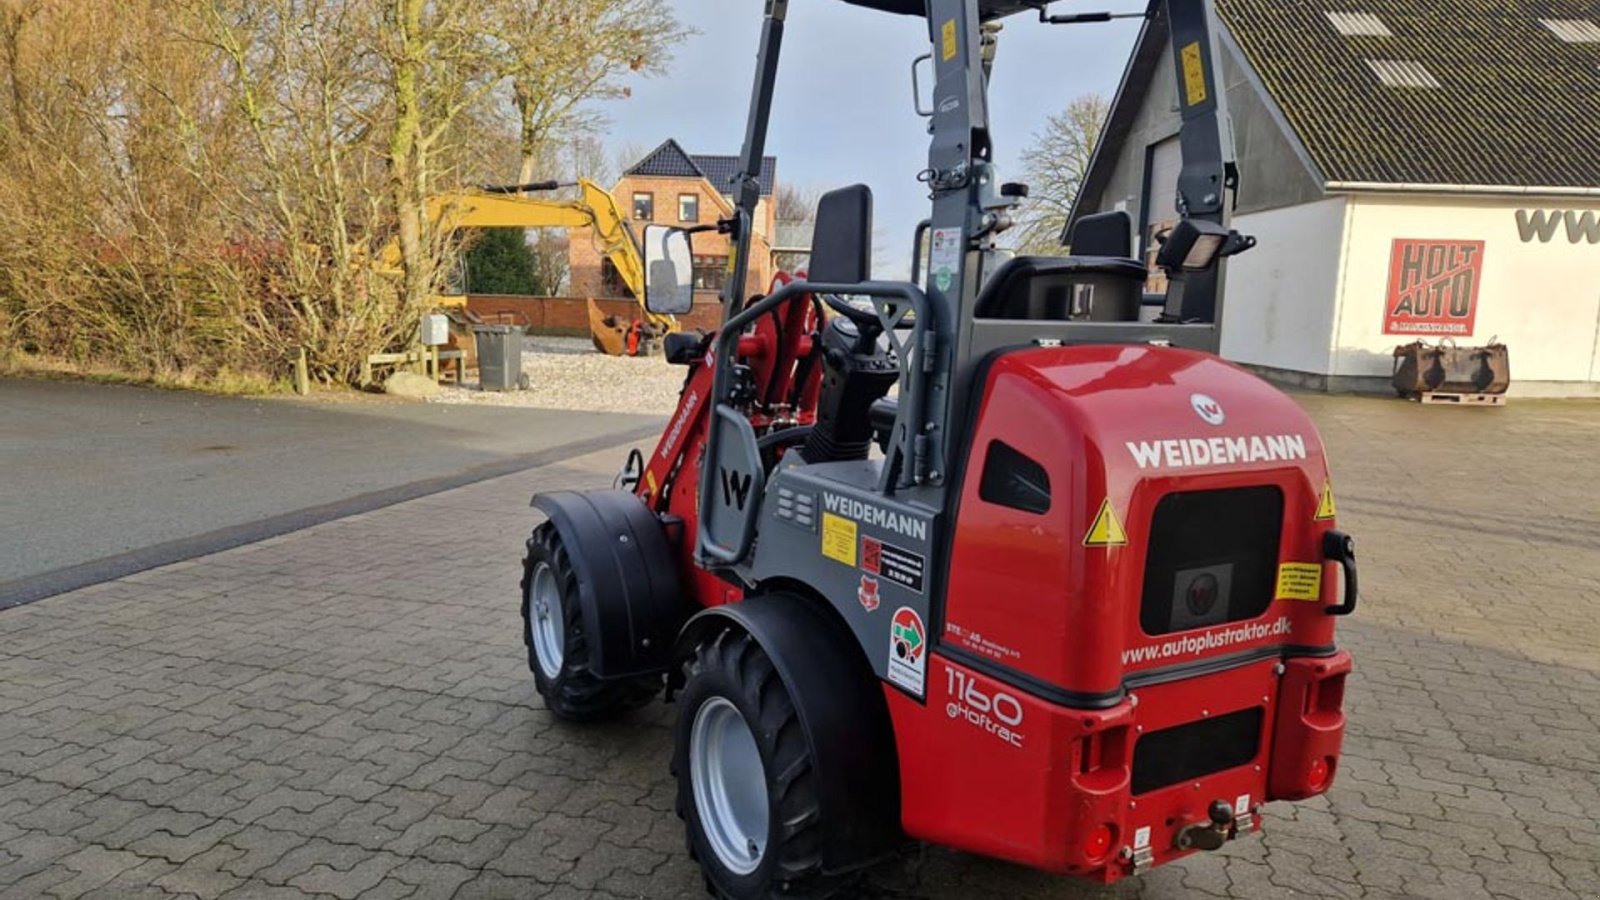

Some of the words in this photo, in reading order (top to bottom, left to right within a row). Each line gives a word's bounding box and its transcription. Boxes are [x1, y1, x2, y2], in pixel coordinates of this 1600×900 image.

[1392, 268, 1473, 317] AUTO
[1400, 244, 1477, 293] HOLT
[660, 391, 698, 459] WEIDEMANN
[1125, 434, 1306, 468] WEIDEMANN
[720, 466, 752, 511] W
[823, 491, 926, 541] WEIDEMANN
[1121, 617, 1292, 664] www.autoplustraktor.dk
[945, 666, 1023, 726] 1160
